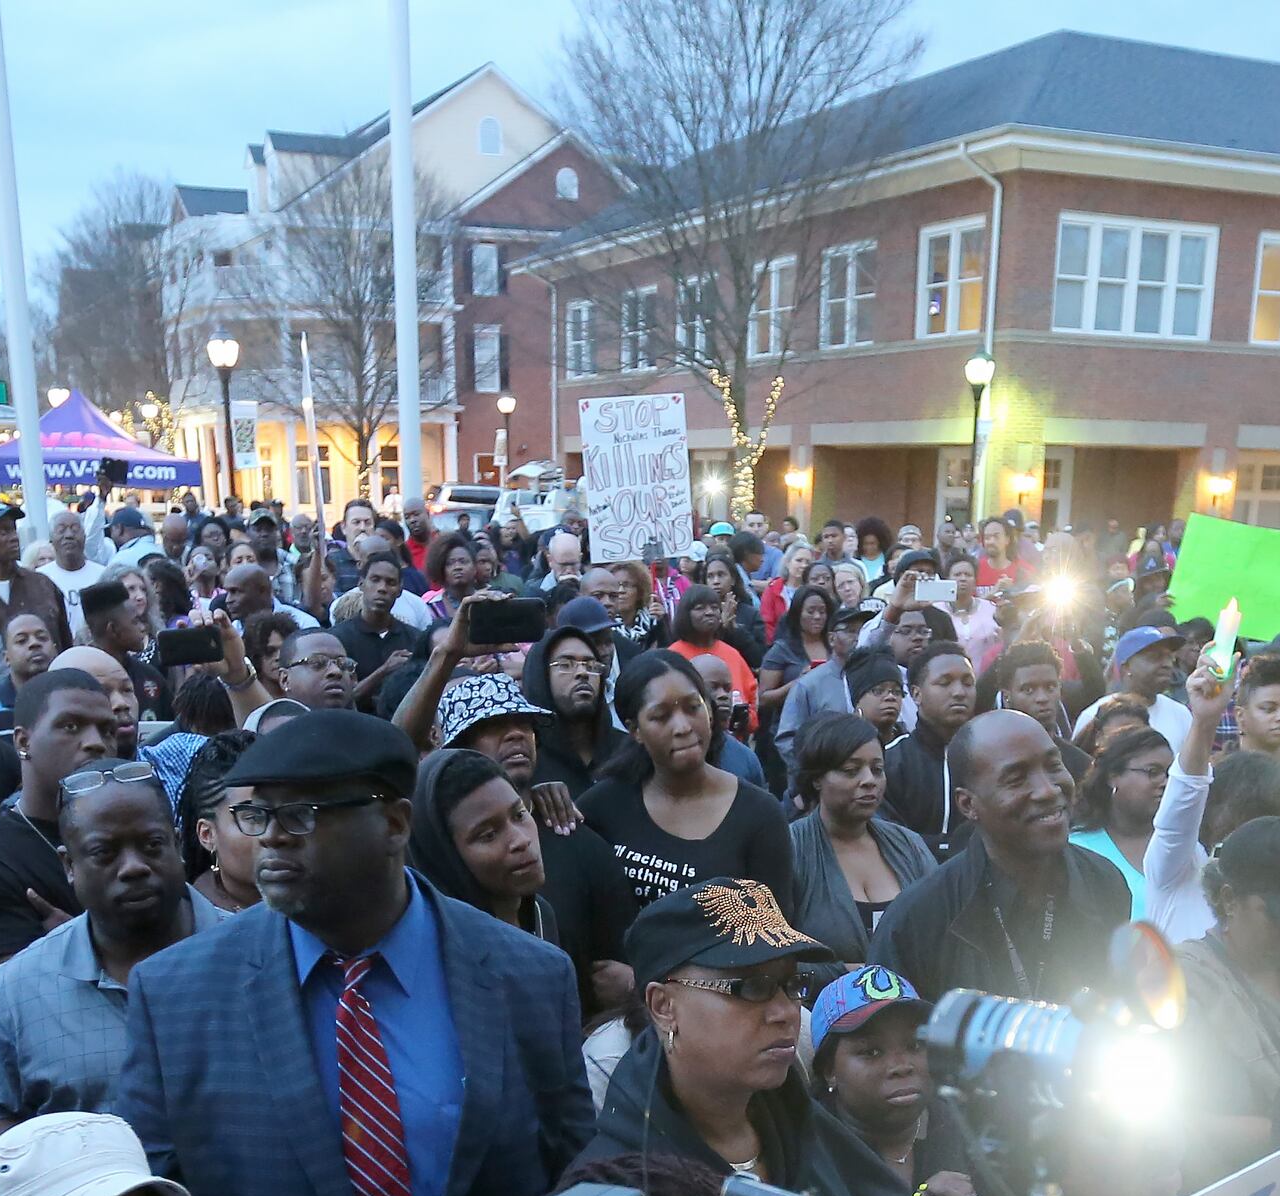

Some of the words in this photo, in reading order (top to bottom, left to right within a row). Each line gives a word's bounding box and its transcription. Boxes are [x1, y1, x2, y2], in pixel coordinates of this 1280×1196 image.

[594, 397, 669, 433] STOP
[4, 459, 177, 481] ww.V-1.com
[612, 485, 671, 527] OUR
[600, 514, 692, 560] SONS
[626, 850, 678, 873] racism
[681, 863, 696, 878] is
[635, 886, 652, 897] of
